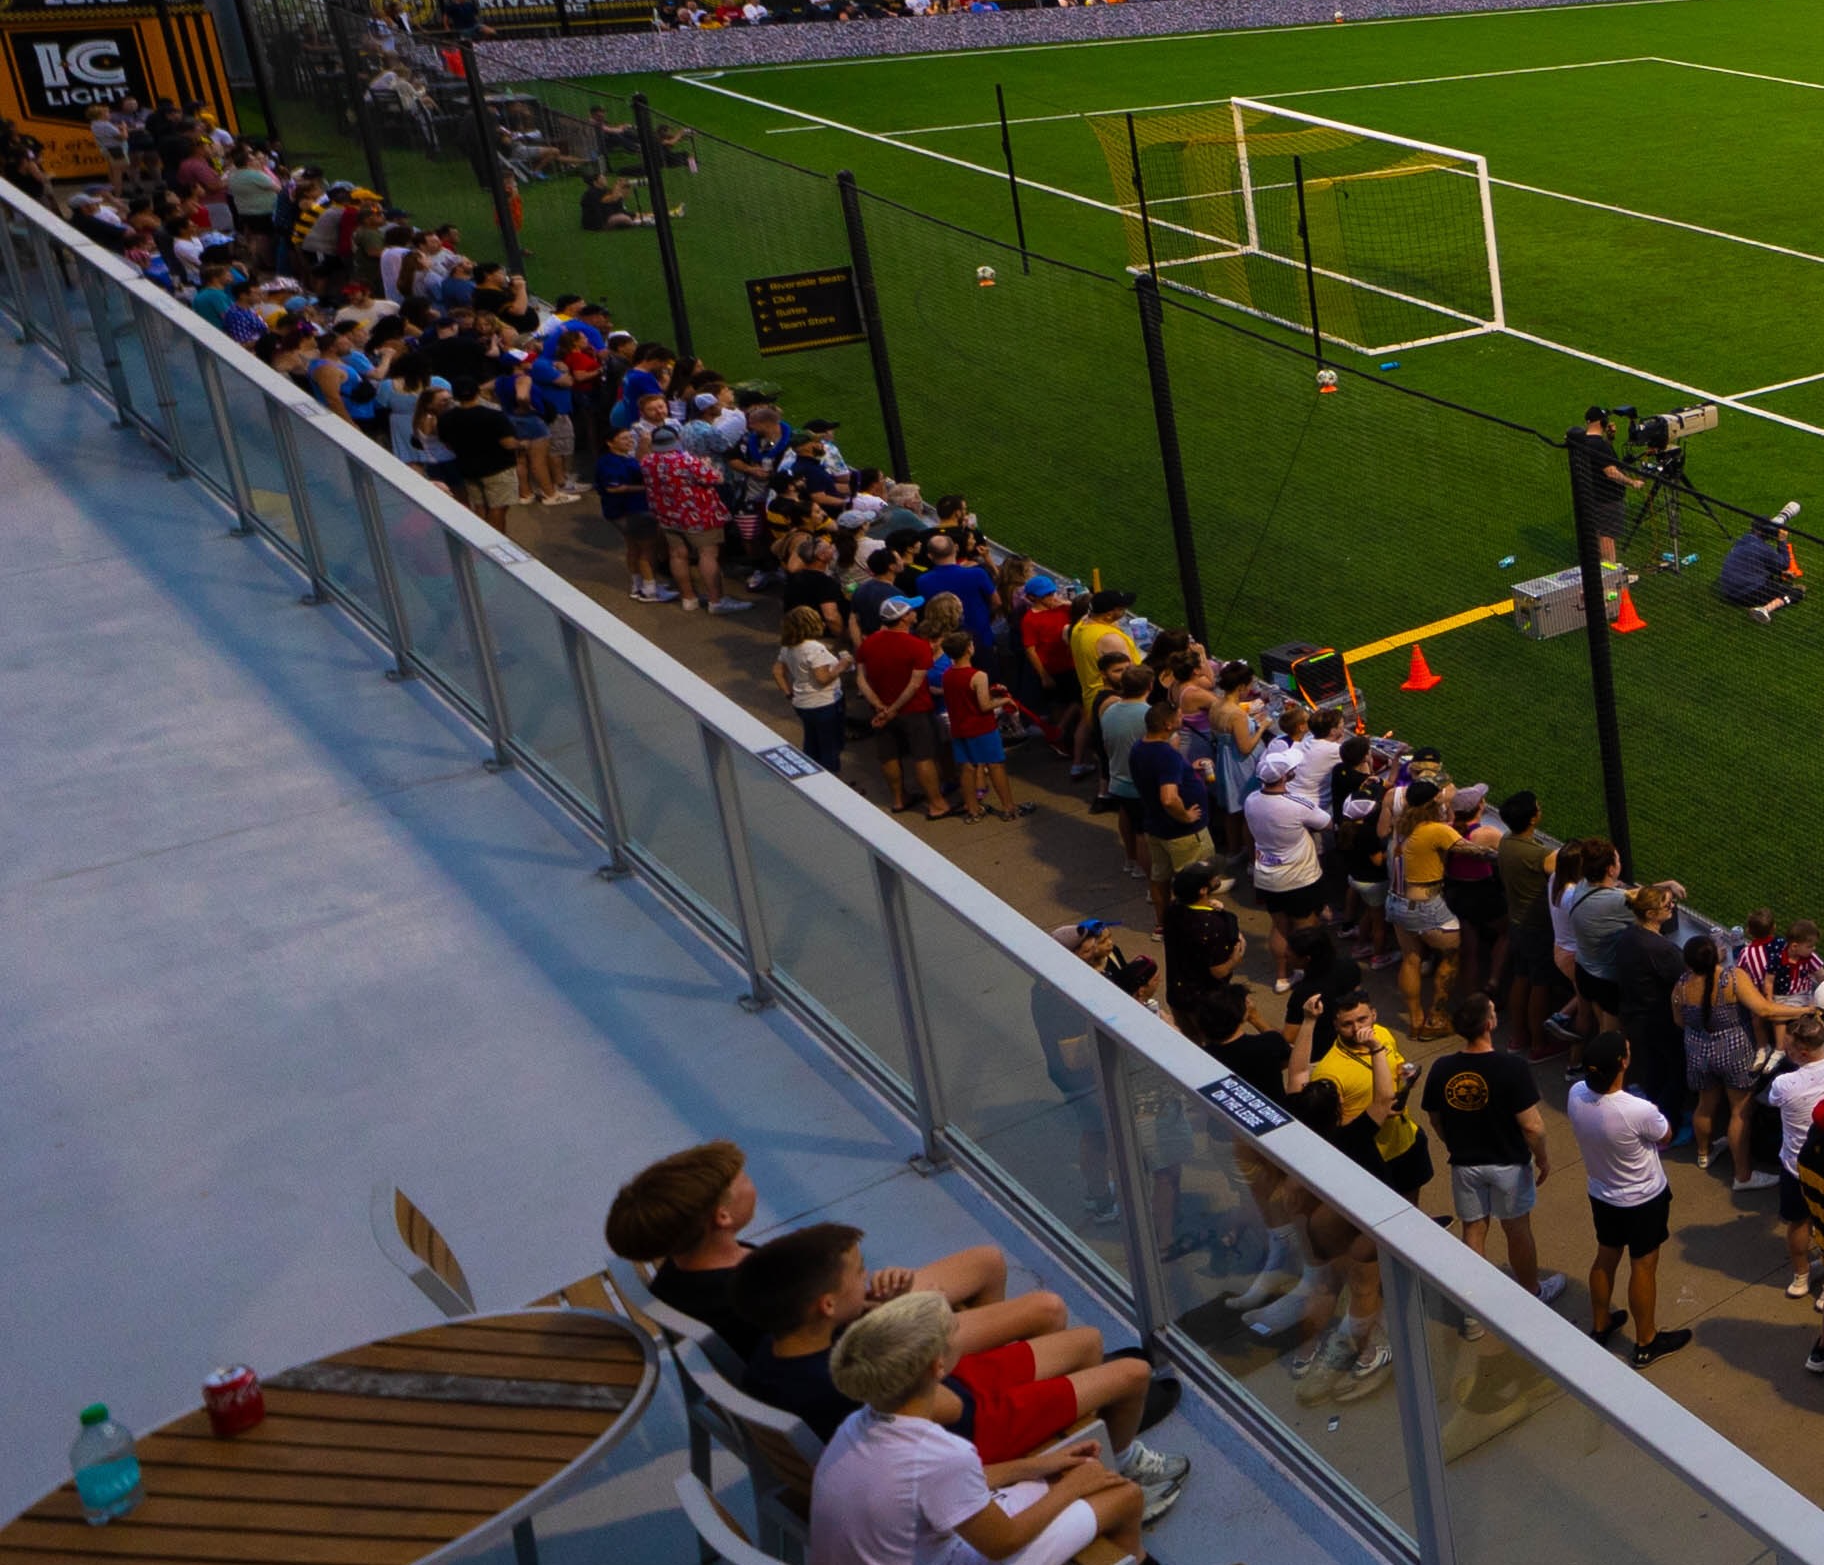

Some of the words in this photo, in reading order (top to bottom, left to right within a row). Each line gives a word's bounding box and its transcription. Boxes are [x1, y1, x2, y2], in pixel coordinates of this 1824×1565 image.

[45, 87, 130, 107] LIGHT
[1231, 1085, 1256, 1103] FOOD
[1257, 1105, 1288, 1127] DRINK
